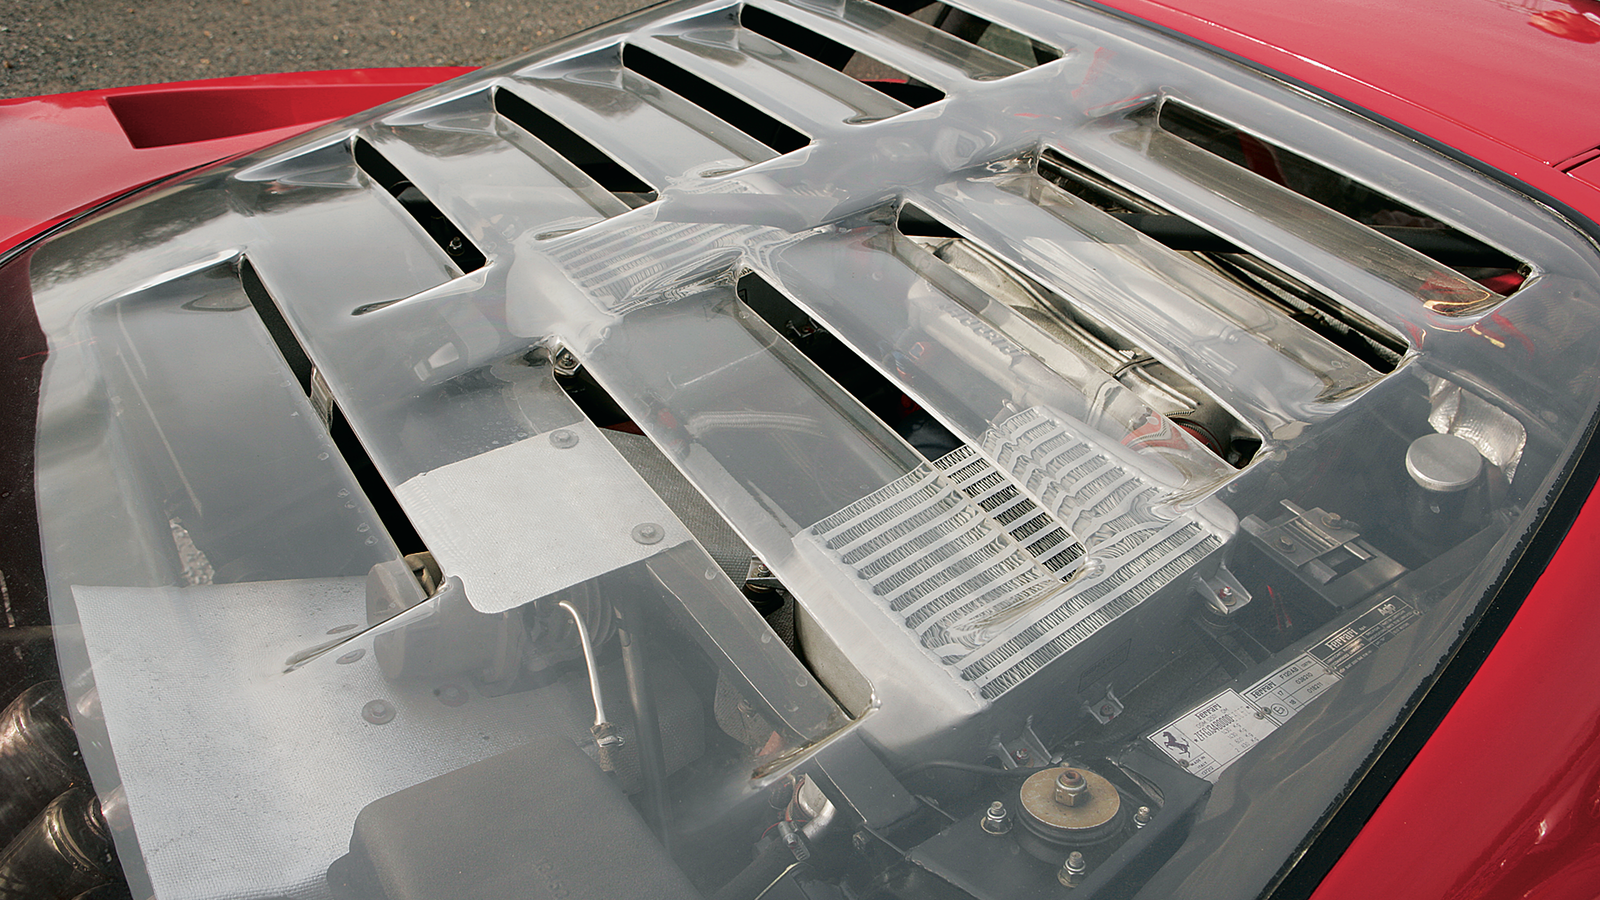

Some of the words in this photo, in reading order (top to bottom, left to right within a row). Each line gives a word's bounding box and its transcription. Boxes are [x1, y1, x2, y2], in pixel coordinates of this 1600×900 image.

[1325, 627, 1358, 651] Ferrari
[1250, 681, 1276, 698] Ferrari
[1195, 702, 1222, 719] Ferrari
